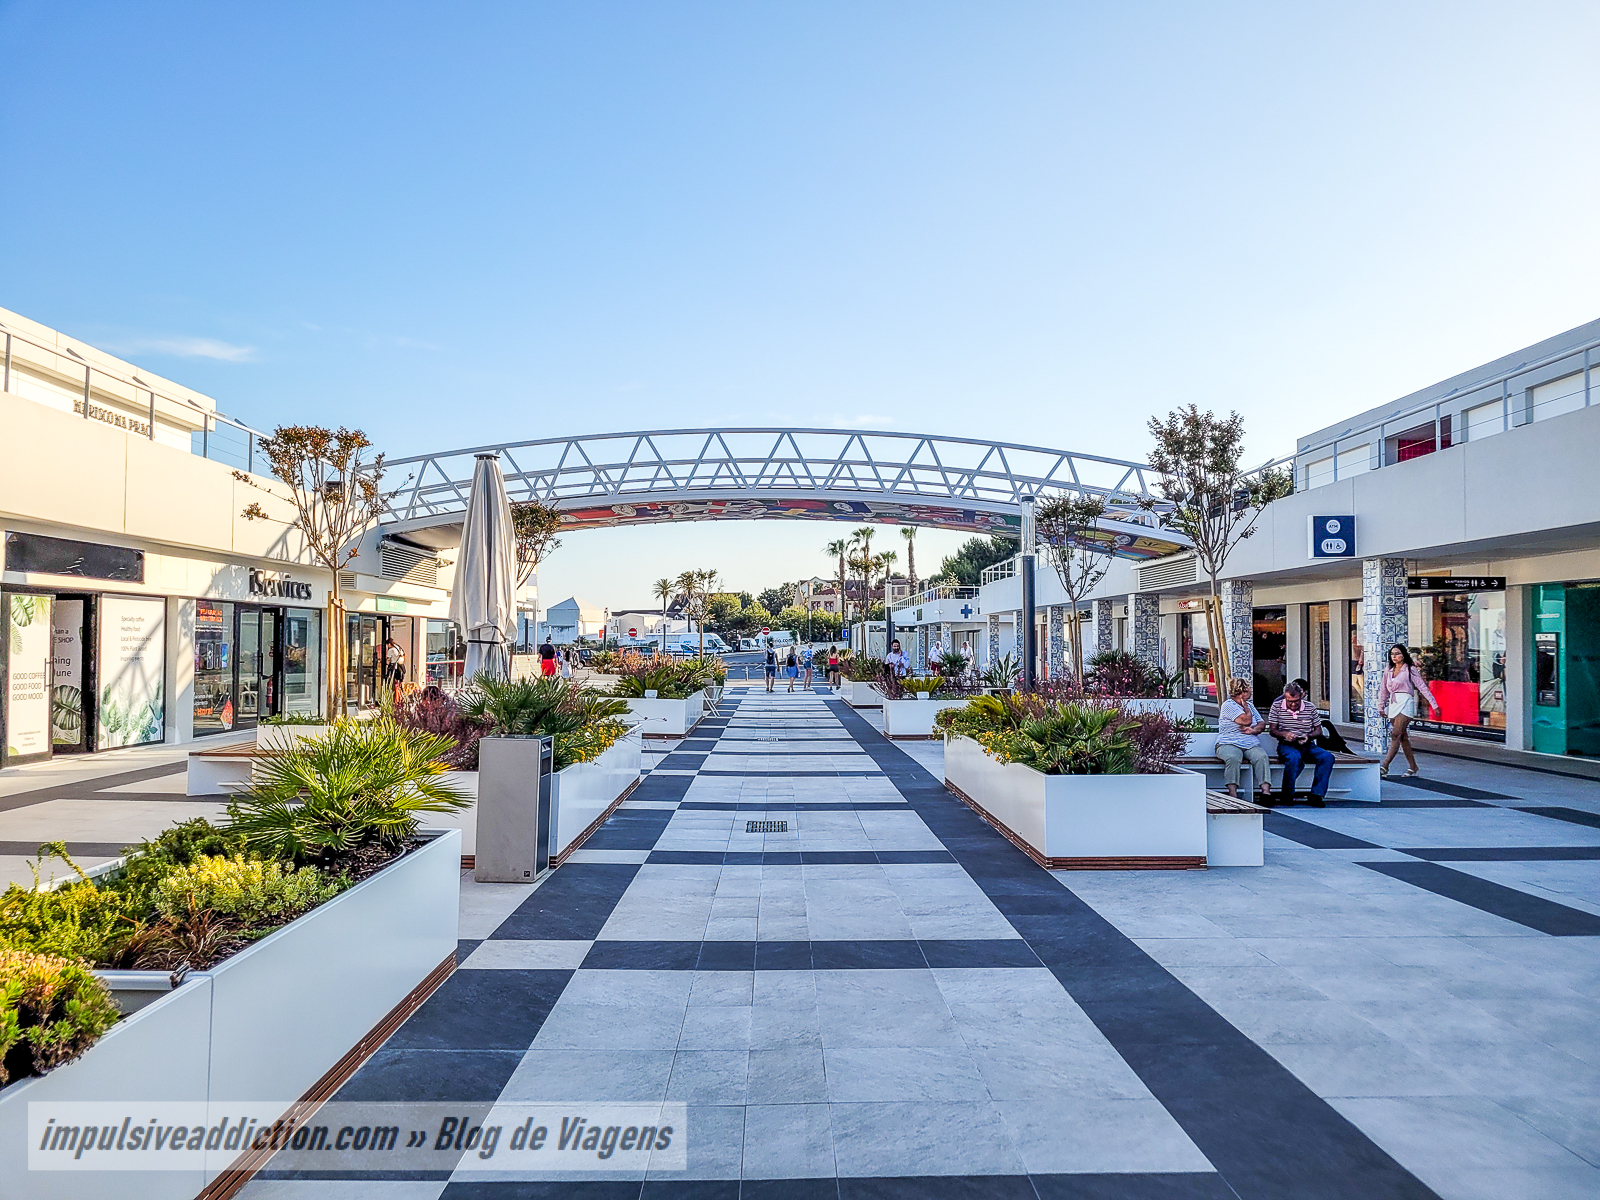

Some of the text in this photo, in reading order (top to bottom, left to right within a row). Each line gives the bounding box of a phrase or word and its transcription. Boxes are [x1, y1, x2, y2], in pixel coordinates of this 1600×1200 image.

[249, 567, 312, 600] iServices
[12, 672, 28, 680] GOOD
[12, 682, 42, 691] GOOD FOOD
[28, 692, 44, 700] MOOD
